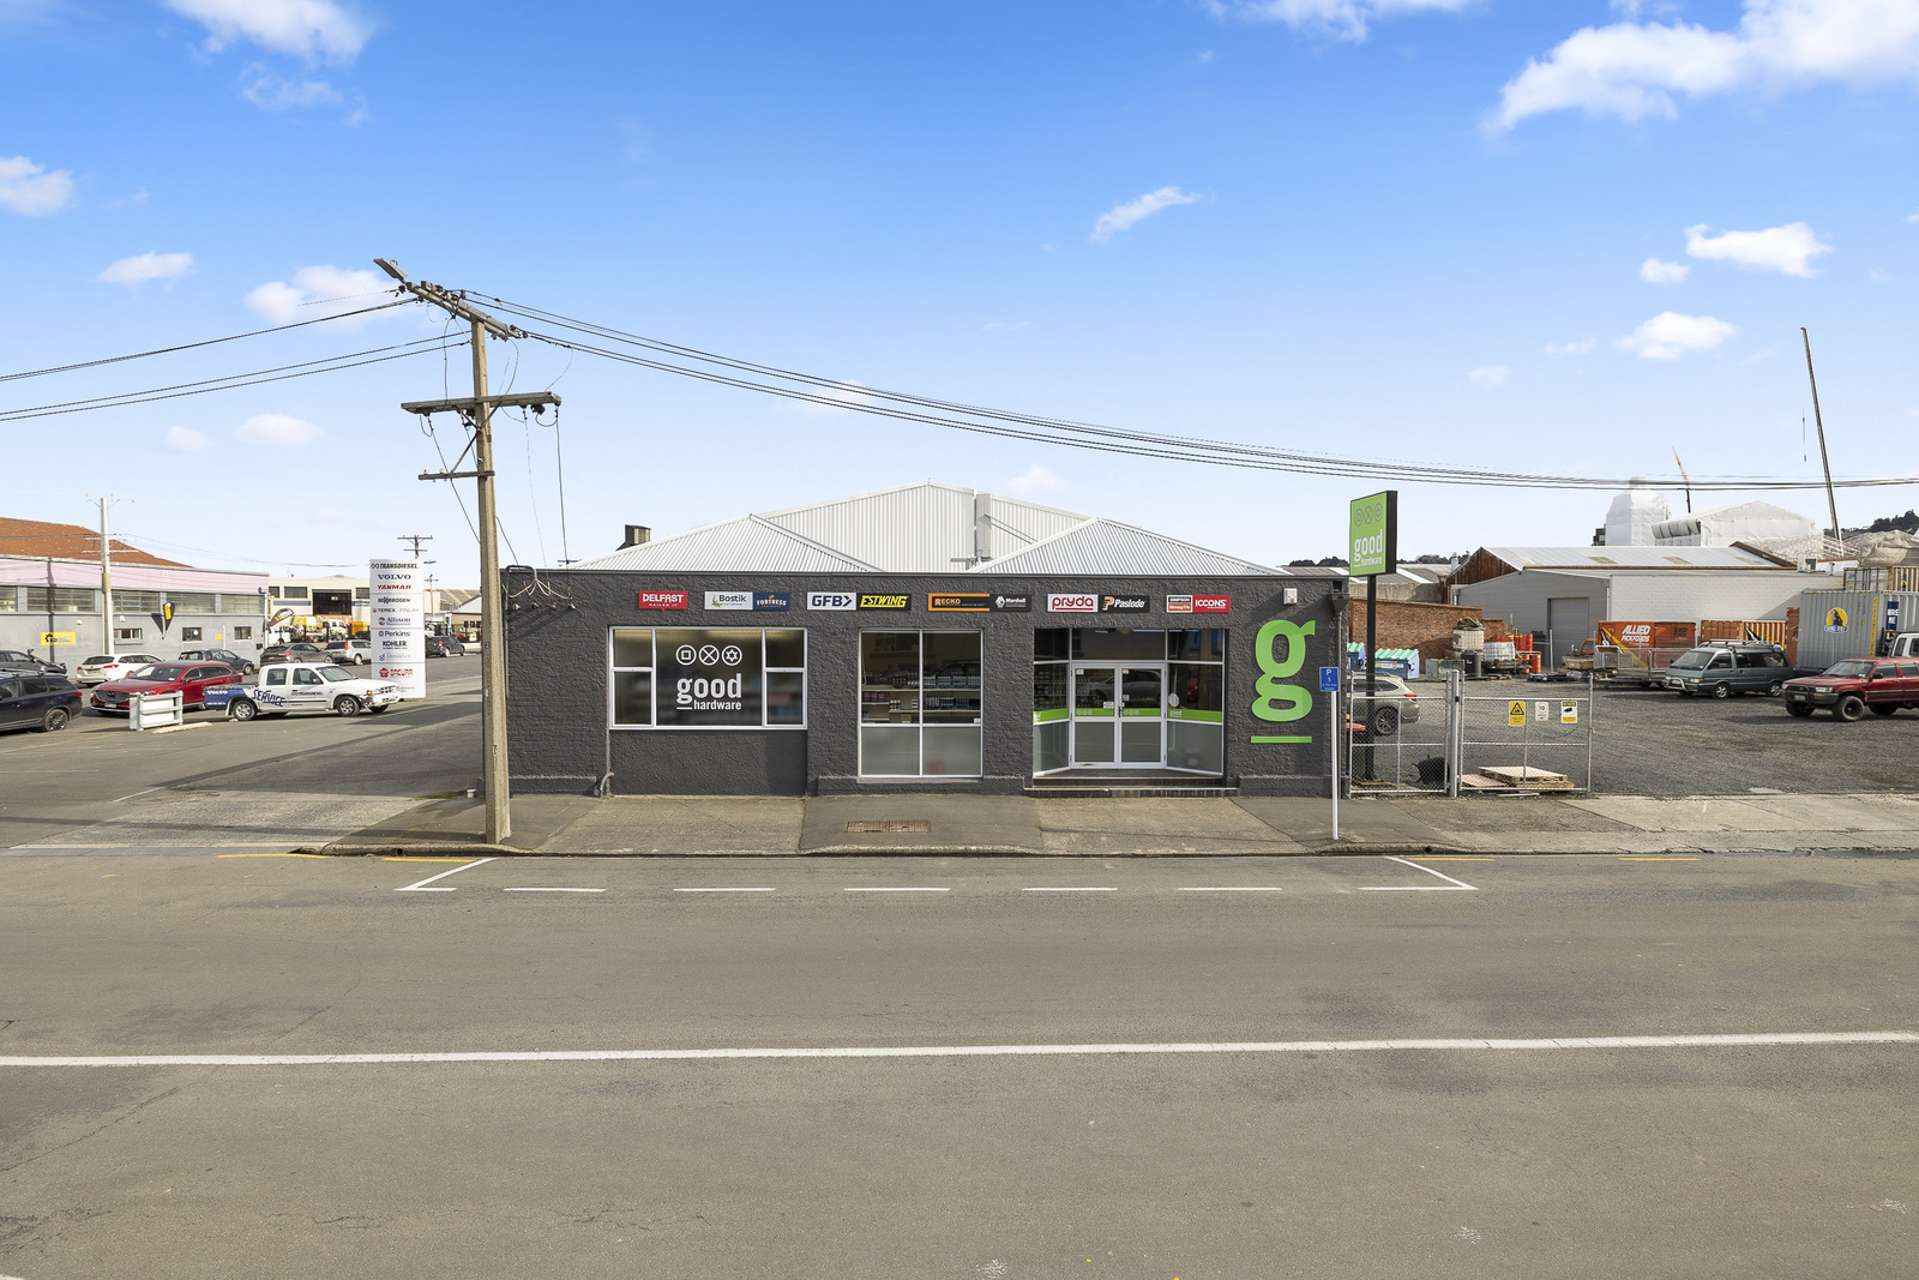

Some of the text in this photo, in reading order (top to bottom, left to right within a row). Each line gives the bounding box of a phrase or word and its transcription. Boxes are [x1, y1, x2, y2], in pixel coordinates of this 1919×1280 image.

[1354, 529, 1383, 562] good
[642, 594, 684, 603] DELFAST
[719, 594, 747, 602] Bostik
[812, 595, 843, 607] GFB
[860, 595, 908, 608] ESTWING
[1052, 596, 1093, 609] pryda
[1114, 599, 1145, 608] Paslode
[1622, 624, 1651, 635] ALLIED
[1251, 619, 1316, 722] g
[1326, 668, 1332, 676] P
[676, 672, 742, 704] good
[252, 689, 285, 707] SERVICE
[693, 699, 742, 710] hardware
